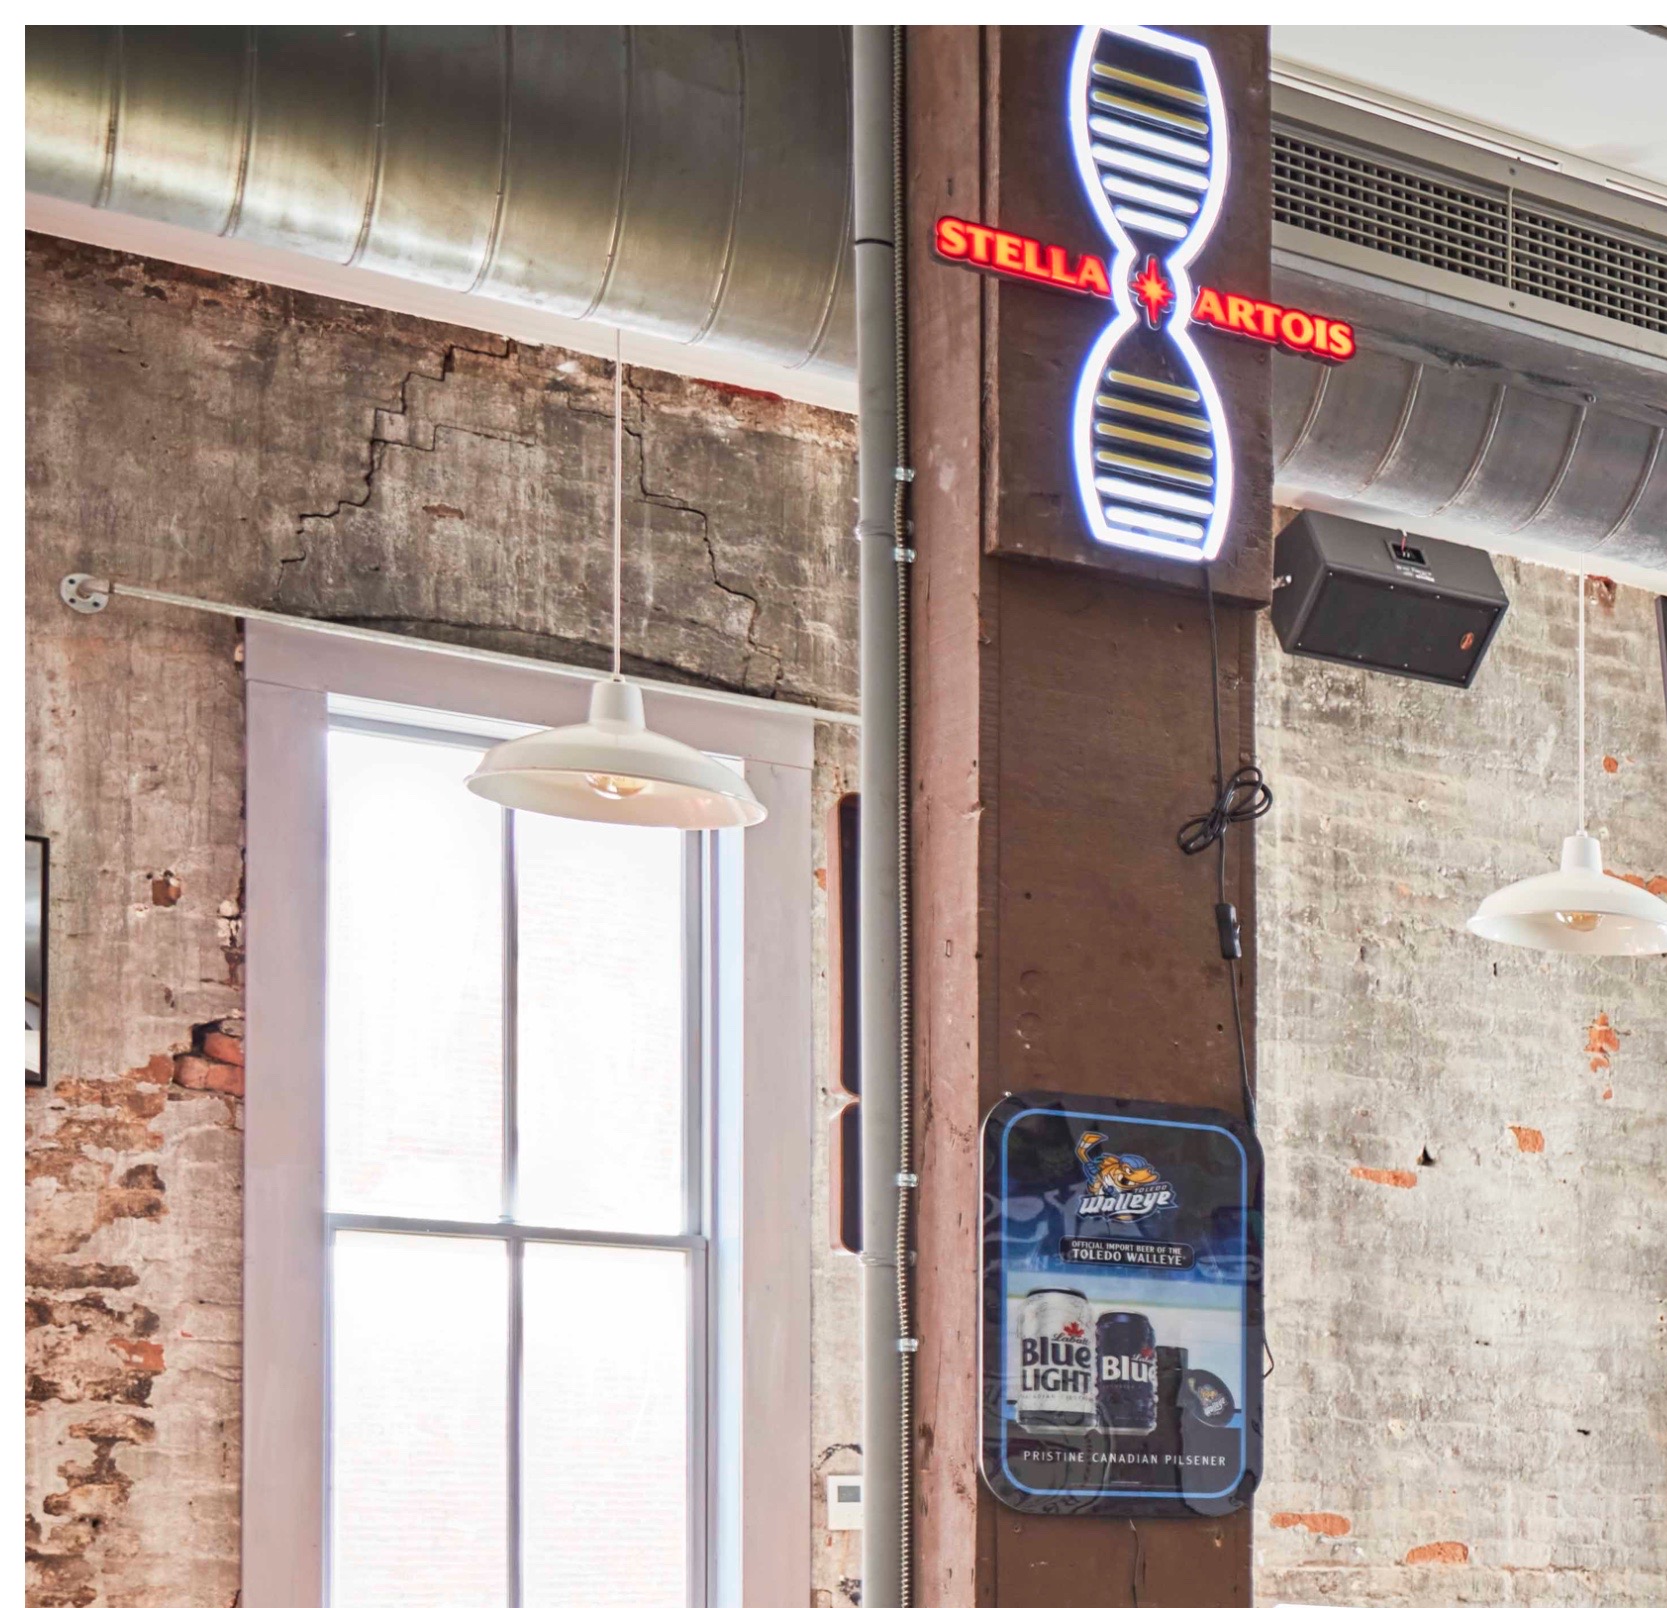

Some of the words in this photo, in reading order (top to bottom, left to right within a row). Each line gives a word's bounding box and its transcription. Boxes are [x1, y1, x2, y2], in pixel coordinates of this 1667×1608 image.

[936, 217, 1111, 296] STELLA
[1194, 288, 1354, 362] ARTOIS
[1134, 1185, 1167, 1193] TOLEDO
[1079, 1190, 1171, 1217] Walleye
[1072, 1241, 1103, 1250] OFFICIAL
[1106, 1243, 1134, 1251] IMPORT
[1136, 1245, 1155, 1253] BEER
[1157, 1246, 1167, 1254] OF
[1169, 1247, 1182, 1255] THE
[1072, 1249, 1122, 1261] TOLEDO
[1127, 1253, 1182, 1266] WALLEYE
[1022, 1336, 1091, 1369] Blue
[1022, 1368, 1091, 1394] LIGHT
[1024, 1451, 1084, 1463] PRISTINE
[1092, 1453, 1158, 1464] CANADIAN
[1165, 1455, 1226, 1466] PILSENER
